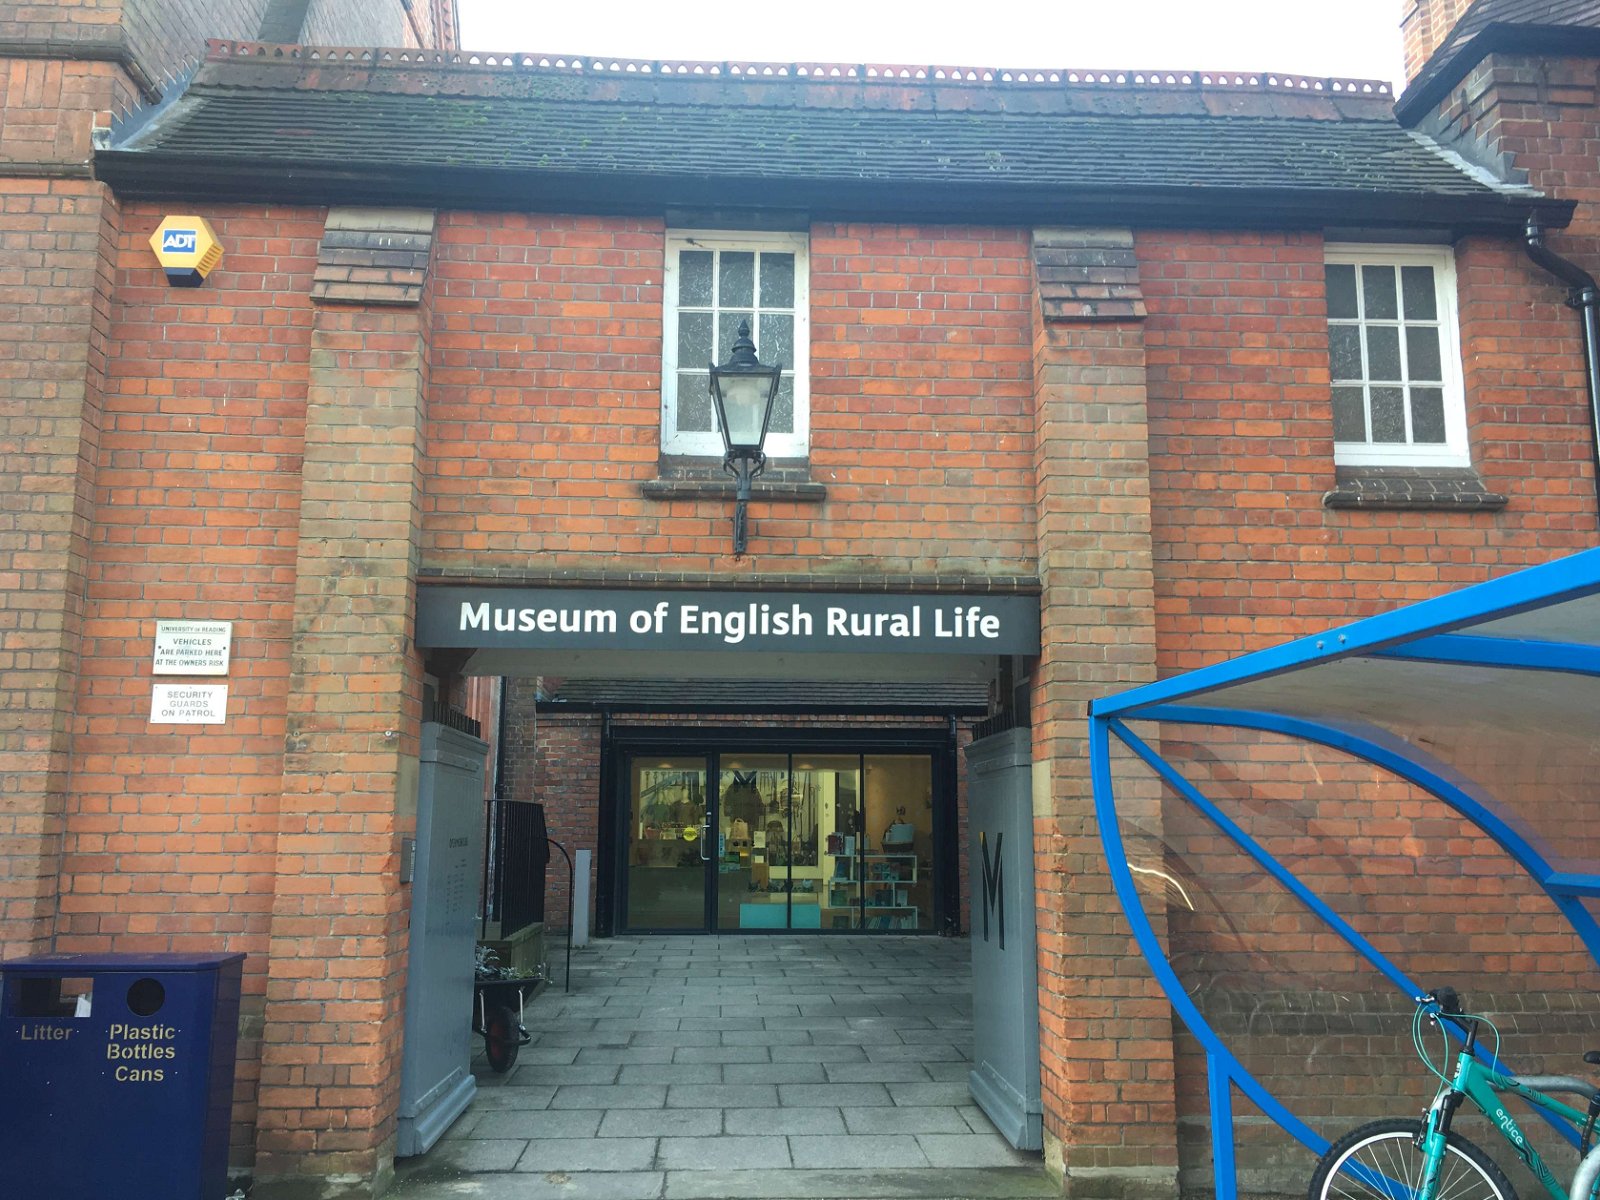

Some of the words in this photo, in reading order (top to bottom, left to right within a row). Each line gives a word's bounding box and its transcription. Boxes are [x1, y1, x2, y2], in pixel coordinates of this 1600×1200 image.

[163, 234, 196, 248] ADT
[458, 601, 617, 633] Museum
[628, 601, 669, 633] of
[680, 603, 814, 643] English
[826, 605, 921, 637] Rural
[933, 606, 1001, 638] Life
[161, 625, 194, 633] UNIVERSITY
[173, 638, 212, 646] VEHICLES
[160, 648, 174, 656] ARE
[205, 649, 222, 657] HERE
[165, 658, 177, 666] THE
[179, 659, 207, 667] OWNERS
[208, 659, 224, 667] RISK
[167, 691, 213, 699] SECURITY
[169, 700, 209, 708] GUARDS
[161, 709, 175, 717] ON
[178, 709, 216, 717] PATROL
[20, 1024, 73, 1041] Litter
[109, 1023, 176, 1041] Plastic
[106, 1043, 176, 1060] Bottles
[114, 1065, 164, 1082] Cans
[1495, 1108, 1524, 1145] entice
